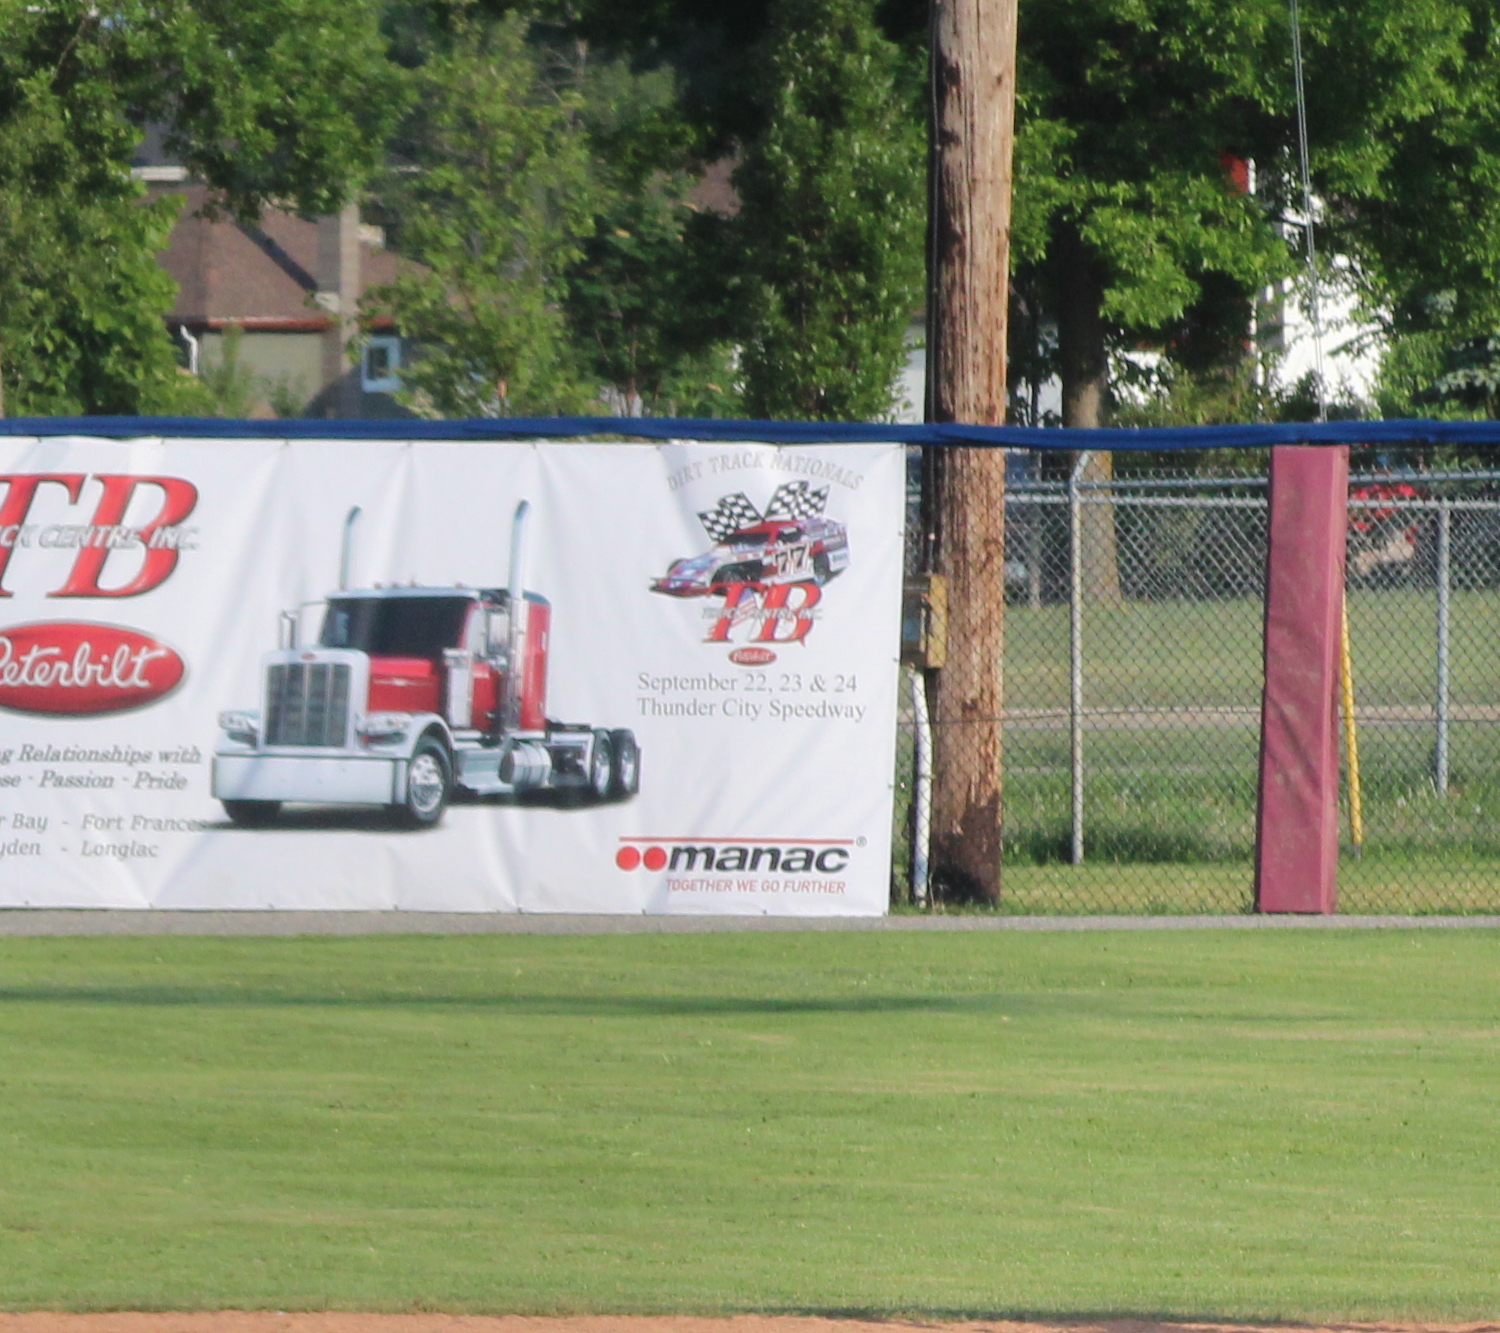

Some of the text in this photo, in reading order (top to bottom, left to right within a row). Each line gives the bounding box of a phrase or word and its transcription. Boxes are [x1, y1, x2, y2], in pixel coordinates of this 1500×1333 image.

[667, 451, 865, 491] DIRT TRACK NATIONALS
[38, 524, 140, 550] CENTRE
[637, 672, 858, 695] September 22, 23 & 24
[637, 697, 867, 723] Thunder City Speedway
[18, 743, 153, 766] Relationships
[158, 745, 201, 764] with
[38, 769, 115, 789] Passion
[133, 771, 188, 790] Pride
[12, 813, 49, 834] Bay
[81, 813, 123, 830] Fort
[80, 840, 159, 861] Longlac
[667, 845, 850, 874] manac
[667, 879, 846, 894] TOGETHER WE GO FURTHER
